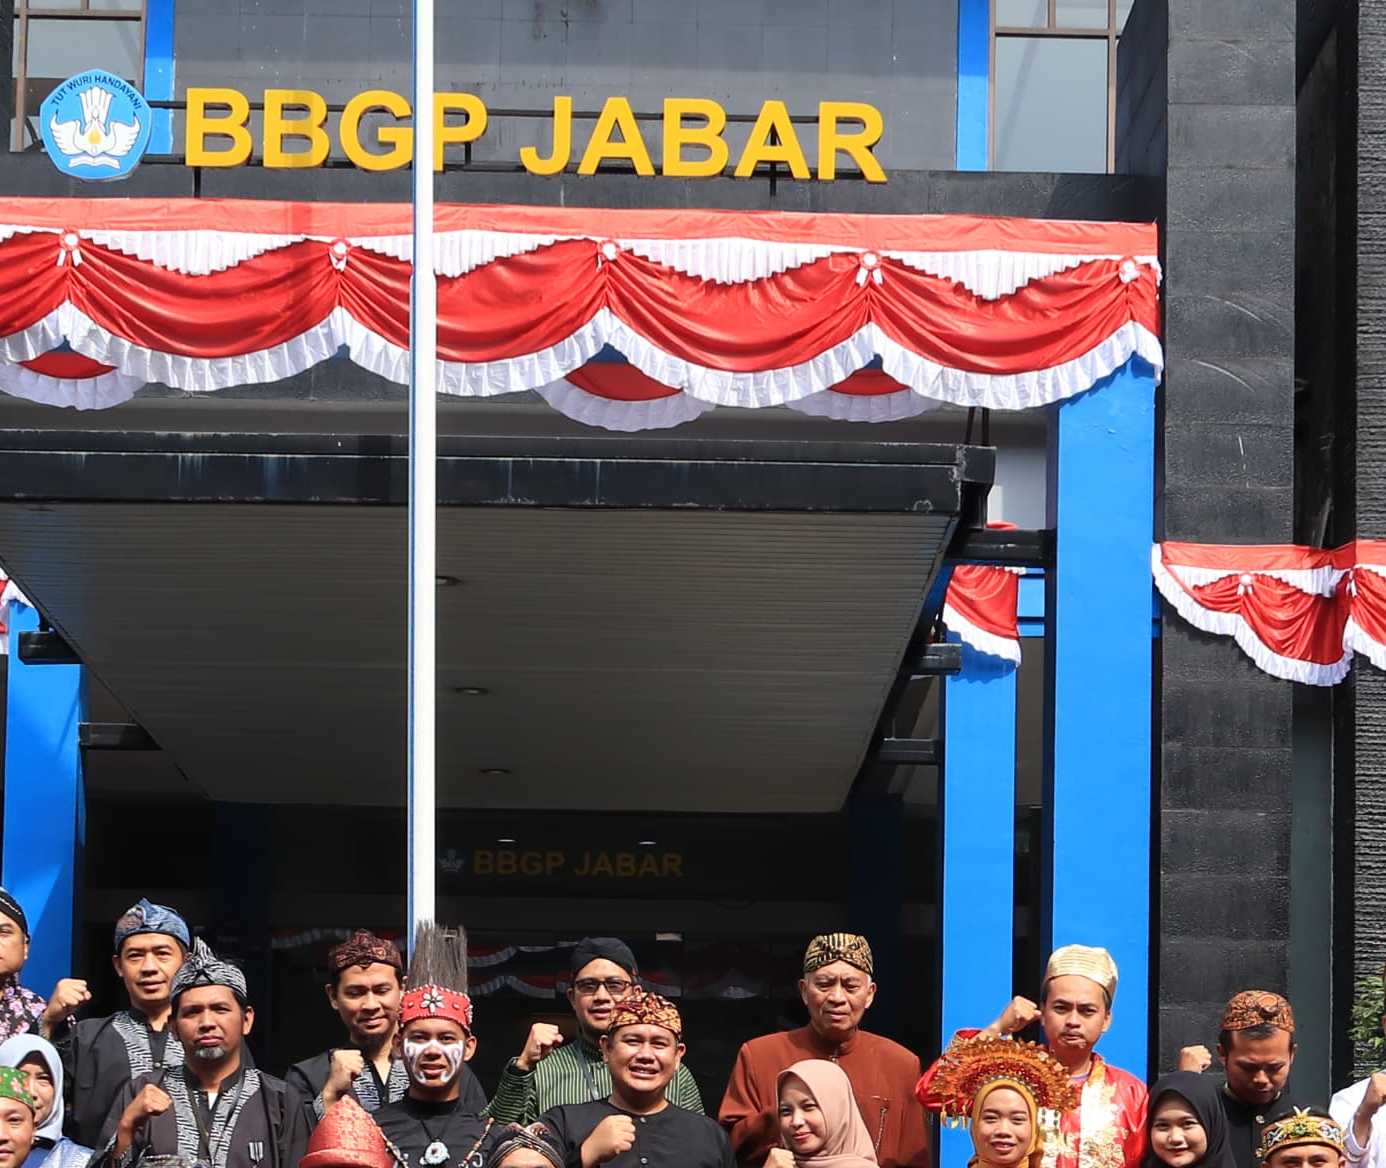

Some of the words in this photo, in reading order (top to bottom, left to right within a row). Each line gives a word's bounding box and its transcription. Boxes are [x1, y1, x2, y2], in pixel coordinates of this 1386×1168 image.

[51, 88, 68, 105] TUT
[67, 76, 92, 91] WURI
[94, 75, 142, 110] HANDAYANI
[185, 87, 489, 172] BBGP
[518, 95, 888, 183] JABAR
[474, 849, 565, 876] BBGP
[573, 850, 685, 879] JABAR
